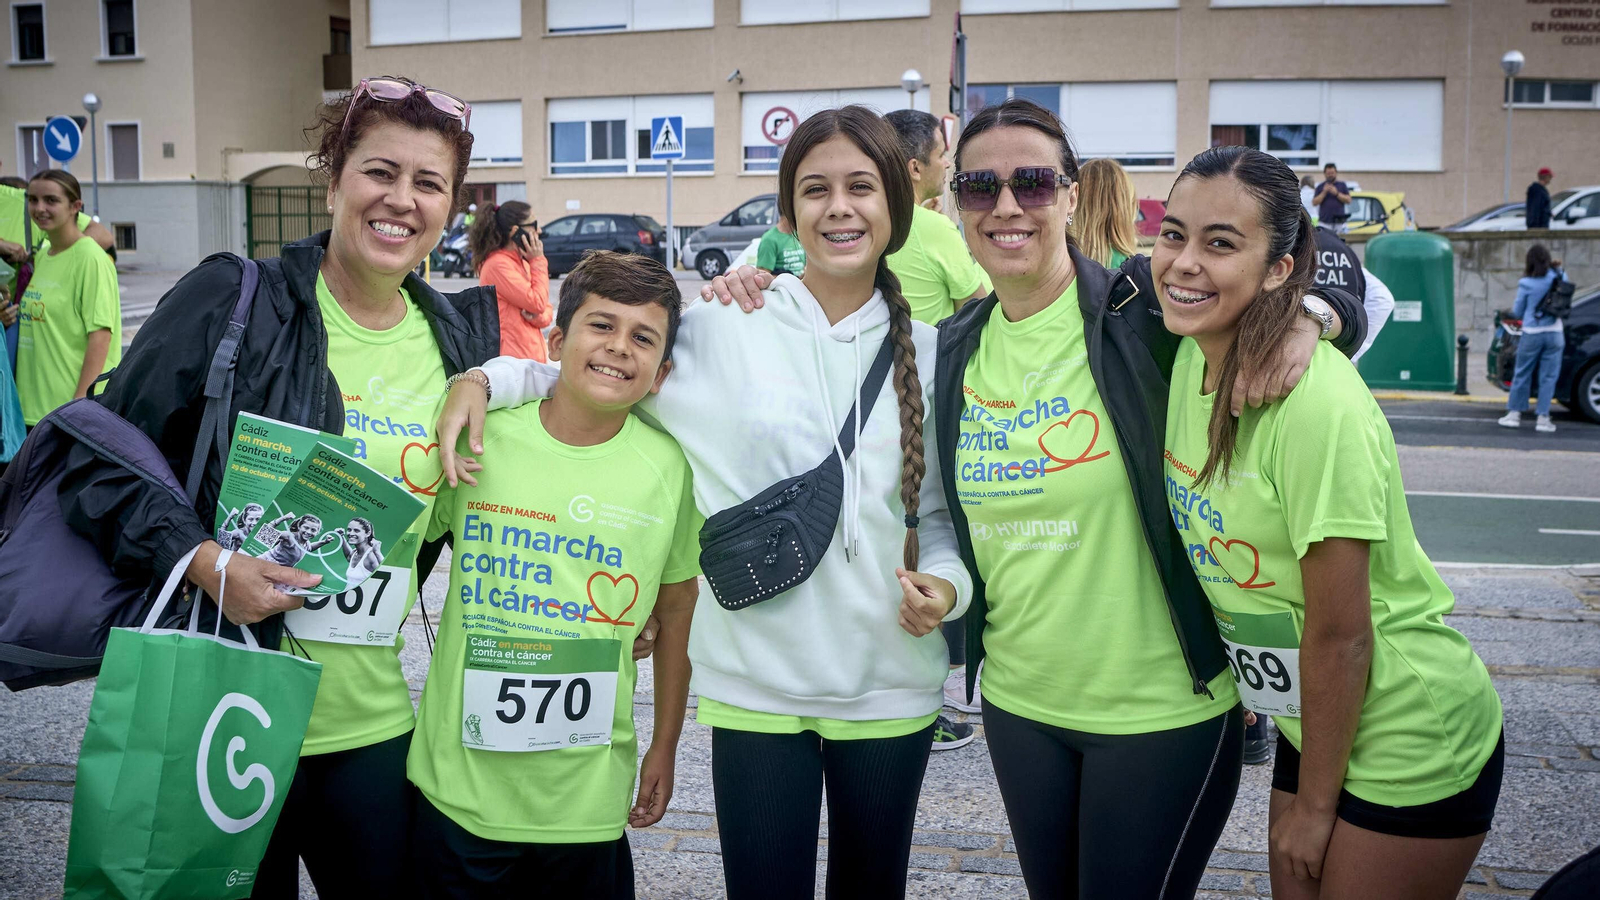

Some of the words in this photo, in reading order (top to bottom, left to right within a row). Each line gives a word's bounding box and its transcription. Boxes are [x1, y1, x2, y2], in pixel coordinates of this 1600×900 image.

[1531, 22, 1545, 32] DE
[1317, 250, 1352, 268] ICIA
[1315, 268, 1348, 286] CAL
[342, 392, 362, 401] CHA
[984, 400, 1016, 409] MARCHA
[241, 422, 269, 438] Cádiz
[345, 408, 428, 438] archa
[238, 434, 251, 443] en
[252, 437, 292, 454] marcha
[957, 425, 1009, 451] ontra
[236, 443, 268, 459] contra
[270, 452, 281, 462] el
[282, 455, 302, 467] cán
[318, 450, 347, 470] Cádiz
[312, 458, 326, 468] en
[327, 465, 366, 489] marcha
[961, 455, 1050, 483] cáncer
[306, 482, 317, 490] de
[307, 464, 341, 485] contra
[342, 481, 354, 492] el
[353, 486, 389, 510] cáncer
[467, 501, 475, 510] IX
[475, 501, 499, 513] CÁDIZ
[499, 505, 513, 514] EN
[514, 508, 557, 523] MARCHA
[995, 521, 1078, 536] HYUNDAI
[463, 514, 493, 543] En
[501, 525, 623, 568] marcha
[1049, 541, 1081, 552] Motor
[460, 552, 553, 585] contra
[461, 577, 484, 605] el
[488, 583, 594, 624] cáncer
[487, 616, 517, 629] ESPAÑOLA
[517, 623, 544, 633] CONTRA
[554, 628, 581, 639] CÁNCER
[471, 638, 497, 648] Cádiz
[498, 641, 511, 649] en
[513, 642, 552, 652] marcha
[472, 648, 503, 658] contra
[504, 650, 515, 659] el
[516, 650, 553, 661] cáncer
[495, 677, 592, 724] 570
